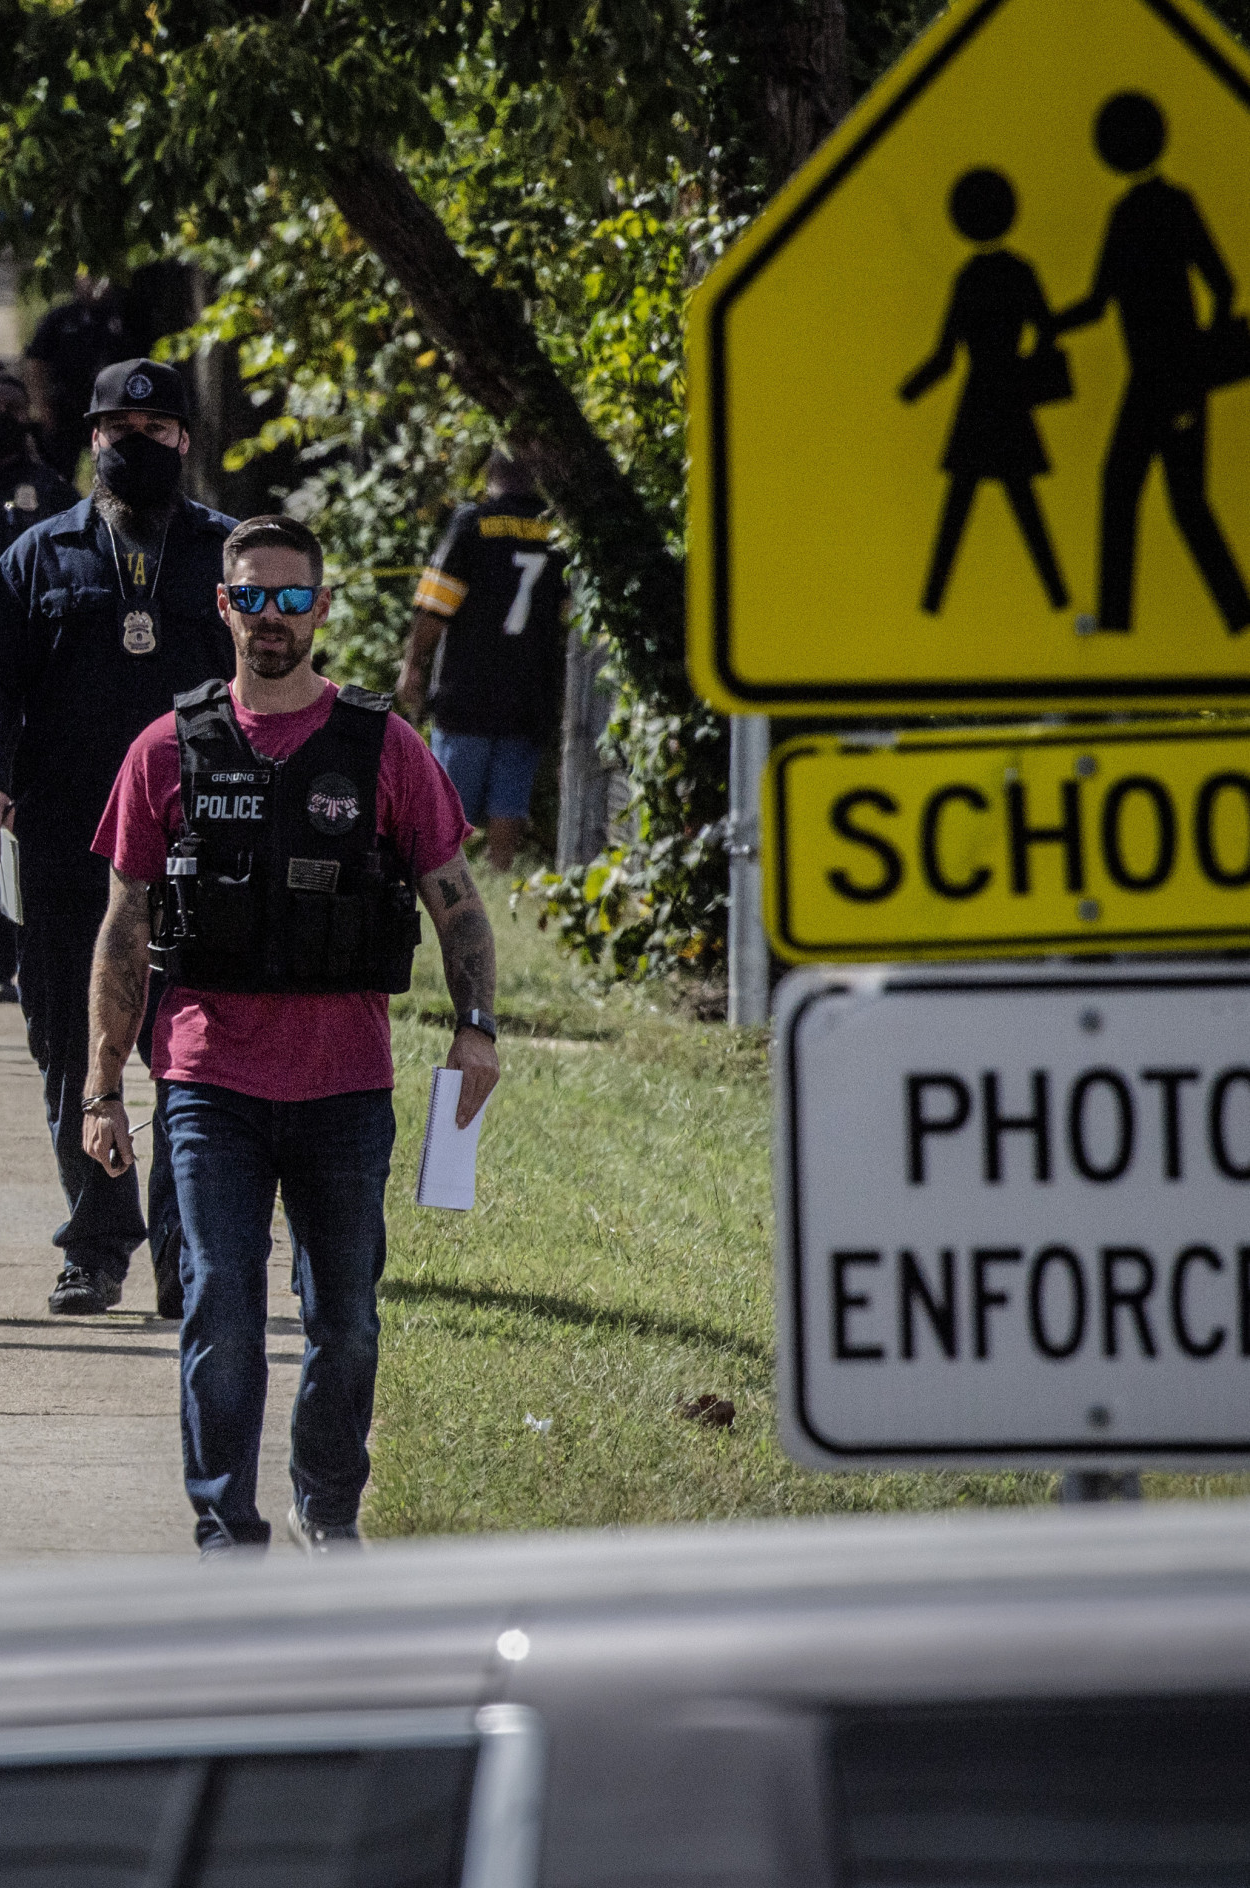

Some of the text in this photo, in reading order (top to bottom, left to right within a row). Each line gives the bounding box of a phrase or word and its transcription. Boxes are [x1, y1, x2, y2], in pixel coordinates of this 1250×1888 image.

[502, 550, 548, 635] 7
[211, 772, 255, 783] GENUNG
[195, 795, 265, 819] POLICE
[829, 1243, 1250, 1362] ENFORC
